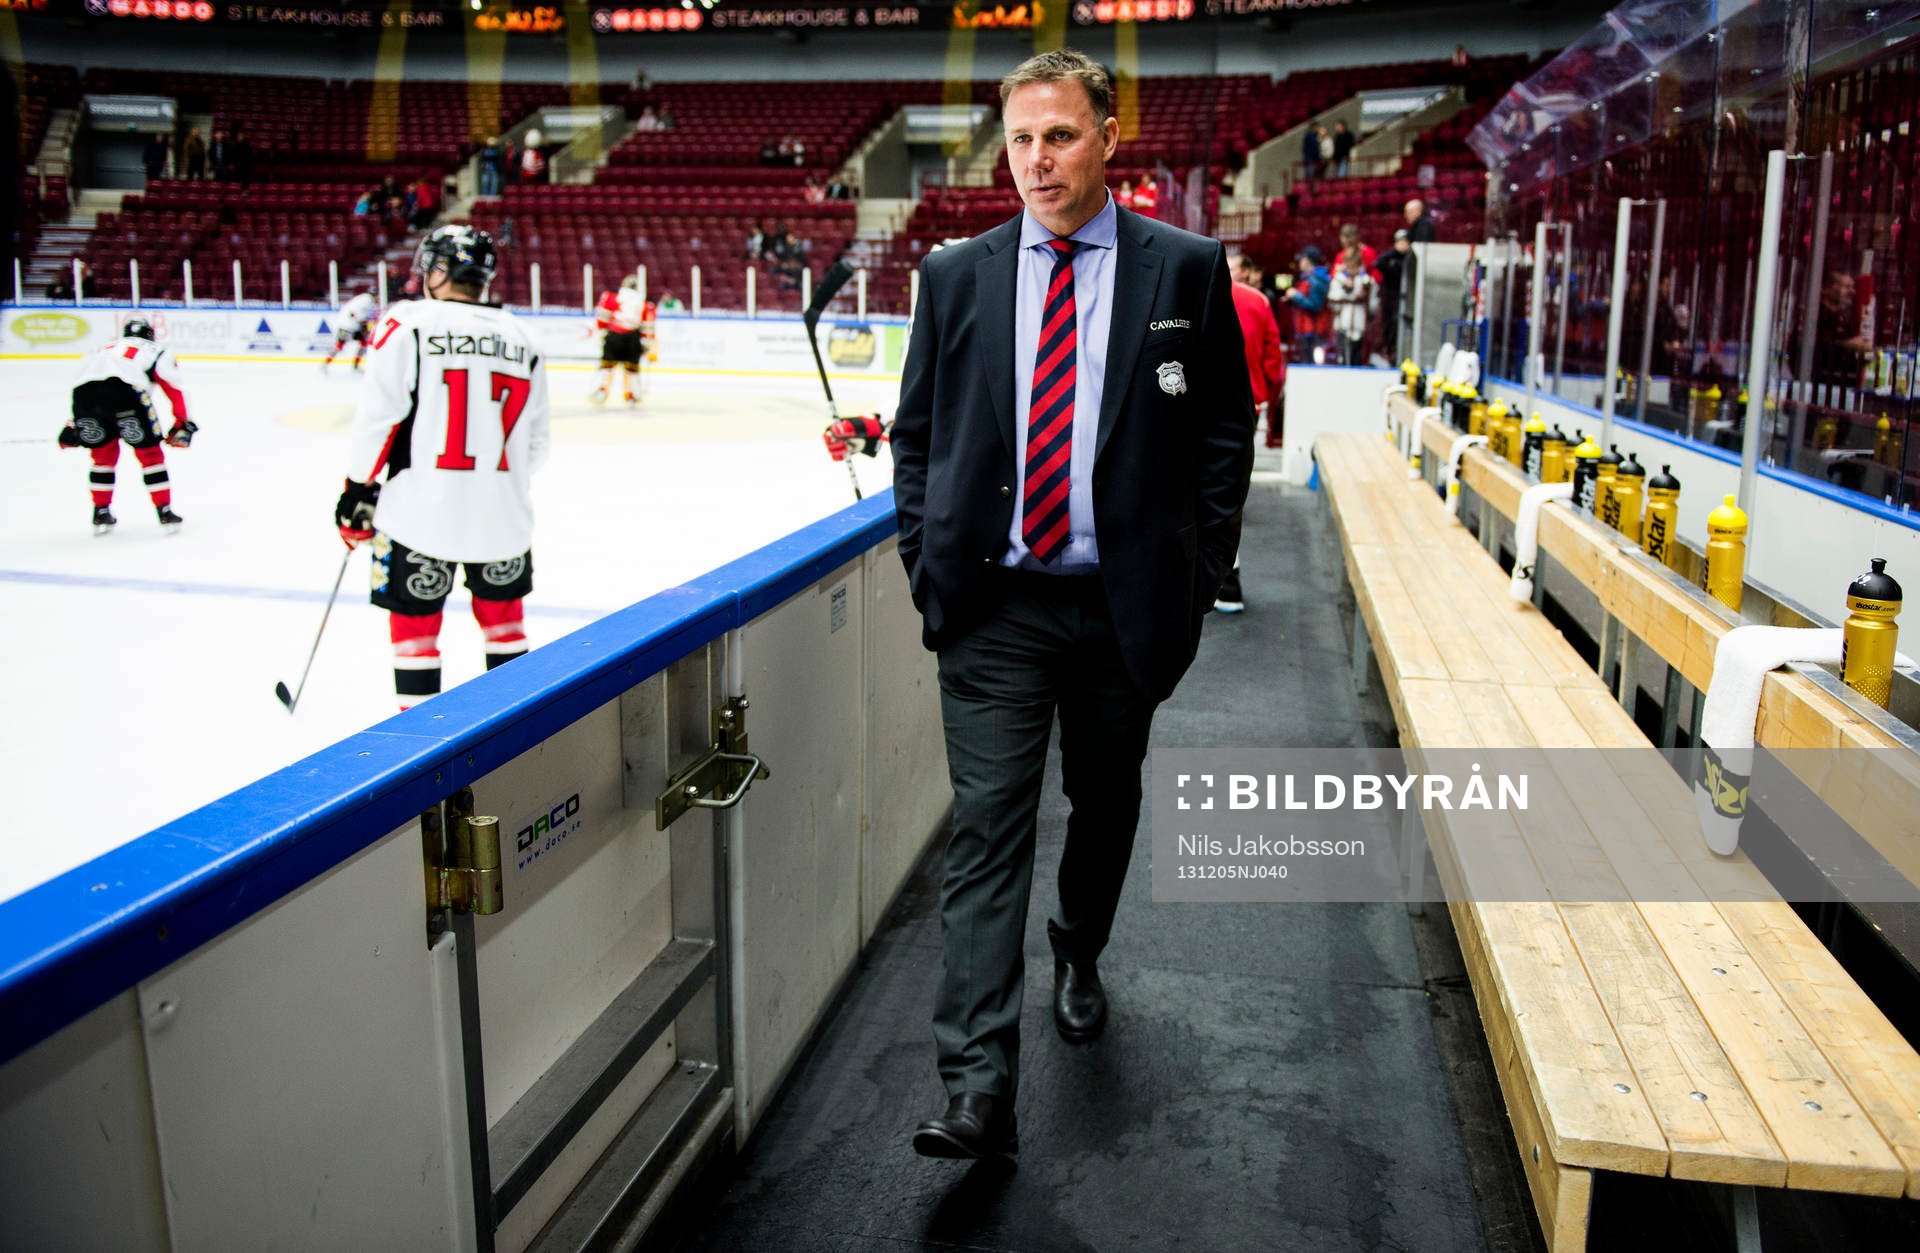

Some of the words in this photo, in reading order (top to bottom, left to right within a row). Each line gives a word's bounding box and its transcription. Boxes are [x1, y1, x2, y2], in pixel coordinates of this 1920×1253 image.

[227, 4, 373, 27] STEAKHOUSE
[381, 12, 394, 26] &
[400, 12, 444, 27] BAR
[712, 8, 850, 27] STEAKHOUSE
[855, 8, 869, 25] &
[875, 7, 920, 25] BAR
[428, 331, 525, 364] stadiu
[435, 368, 531, 471] 17
[518, 793, 579, 853] DACO
[519, 820, 580, 870] www.daco.se
